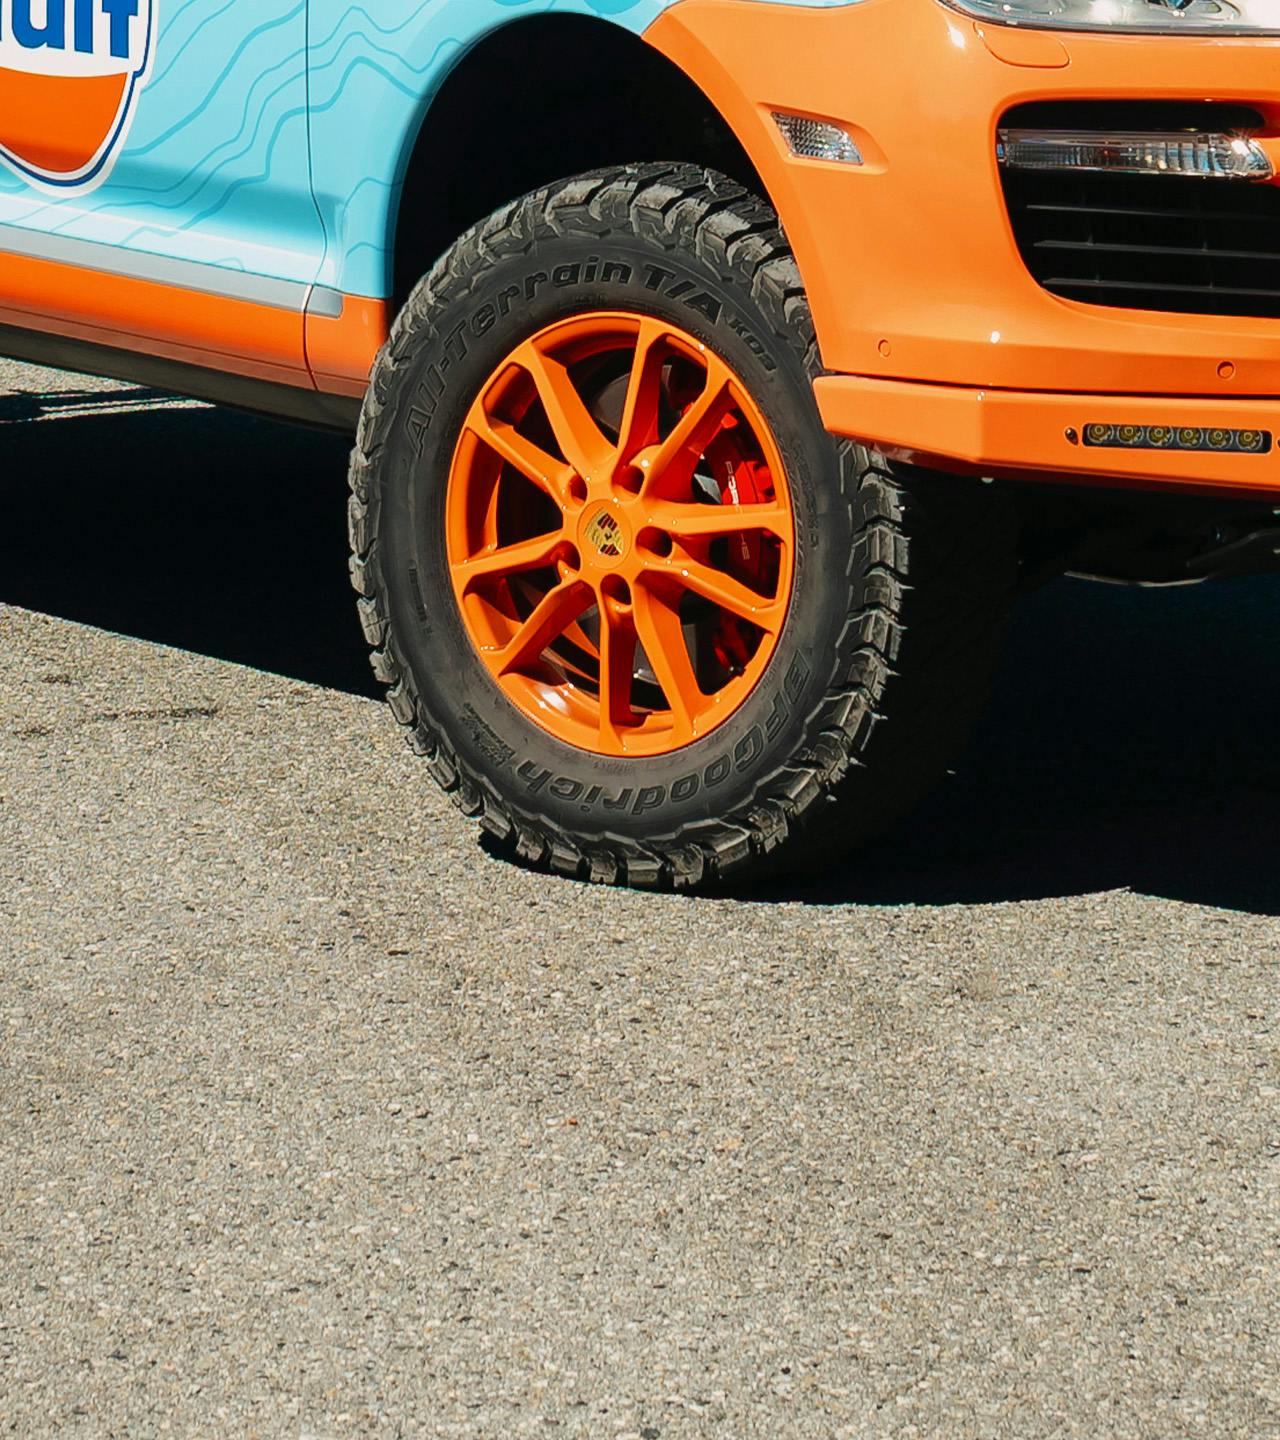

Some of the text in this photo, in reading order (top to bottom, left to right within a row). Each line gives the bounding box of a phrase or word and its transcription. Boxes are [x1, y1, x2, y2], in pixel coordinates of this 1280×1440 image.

[404, 255, 634, 458] All-Terrain
[643, 262, 724, 326] T/A
[516, 647, 812, 816] BFGoodrich
